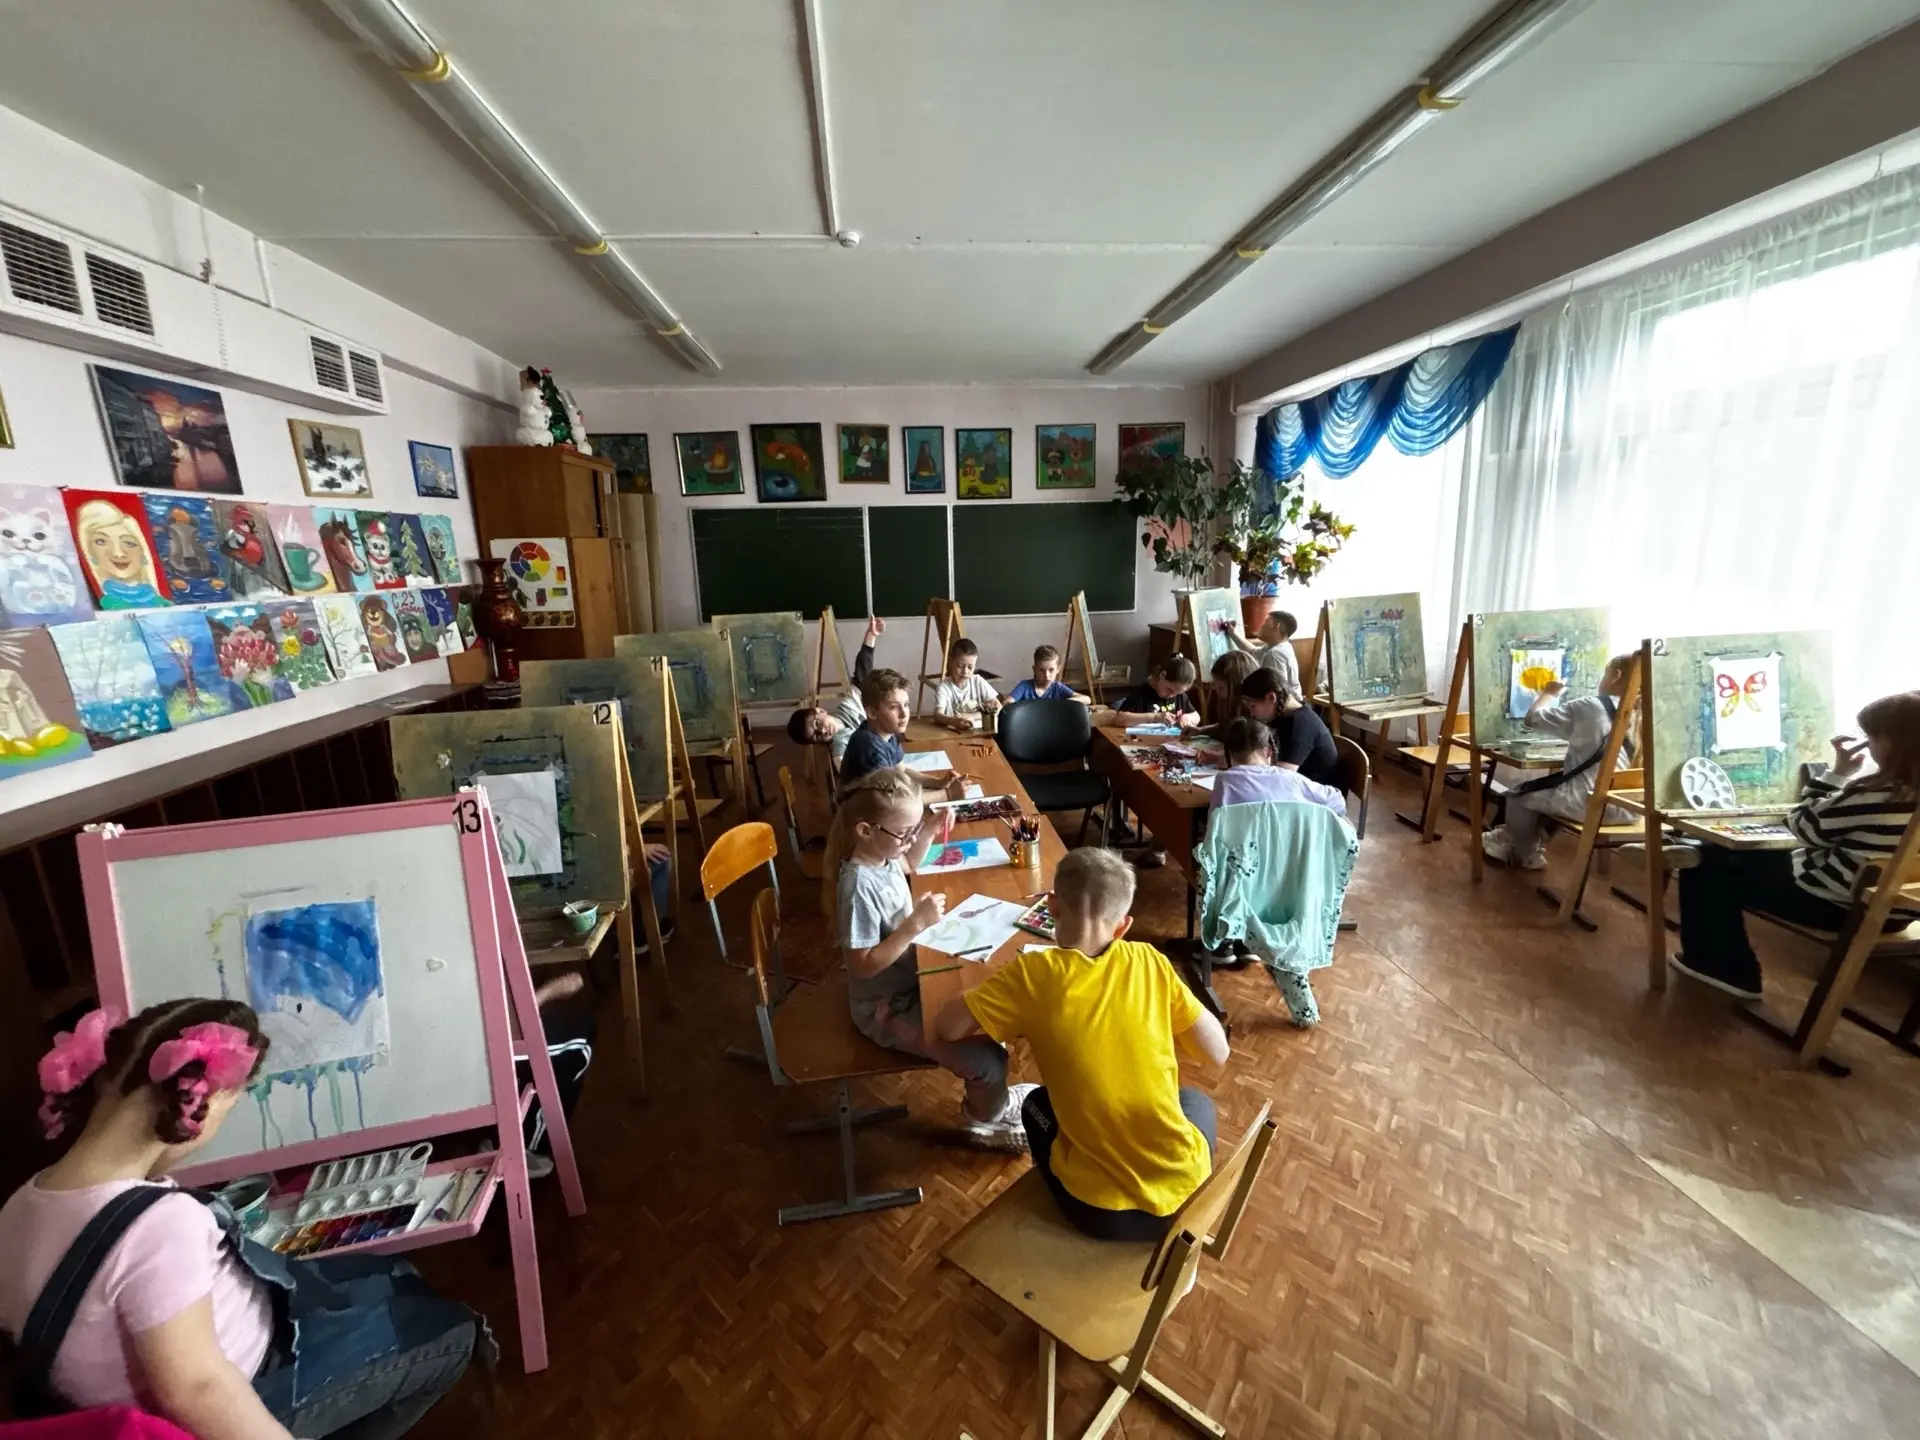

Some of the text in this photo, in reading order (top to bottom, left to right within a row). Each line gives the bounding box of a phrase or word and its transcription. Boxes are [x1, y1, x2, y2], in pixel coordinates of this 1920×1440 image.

[1475, 613, 1485, 627] 3
[718, 629, 729, 642] 10
[1653, 638, 1669, 657] 2
[651, 656, 663, 671] 11
[593, 703, 612, 726] 12
[452, 799, 482, 835] 13
